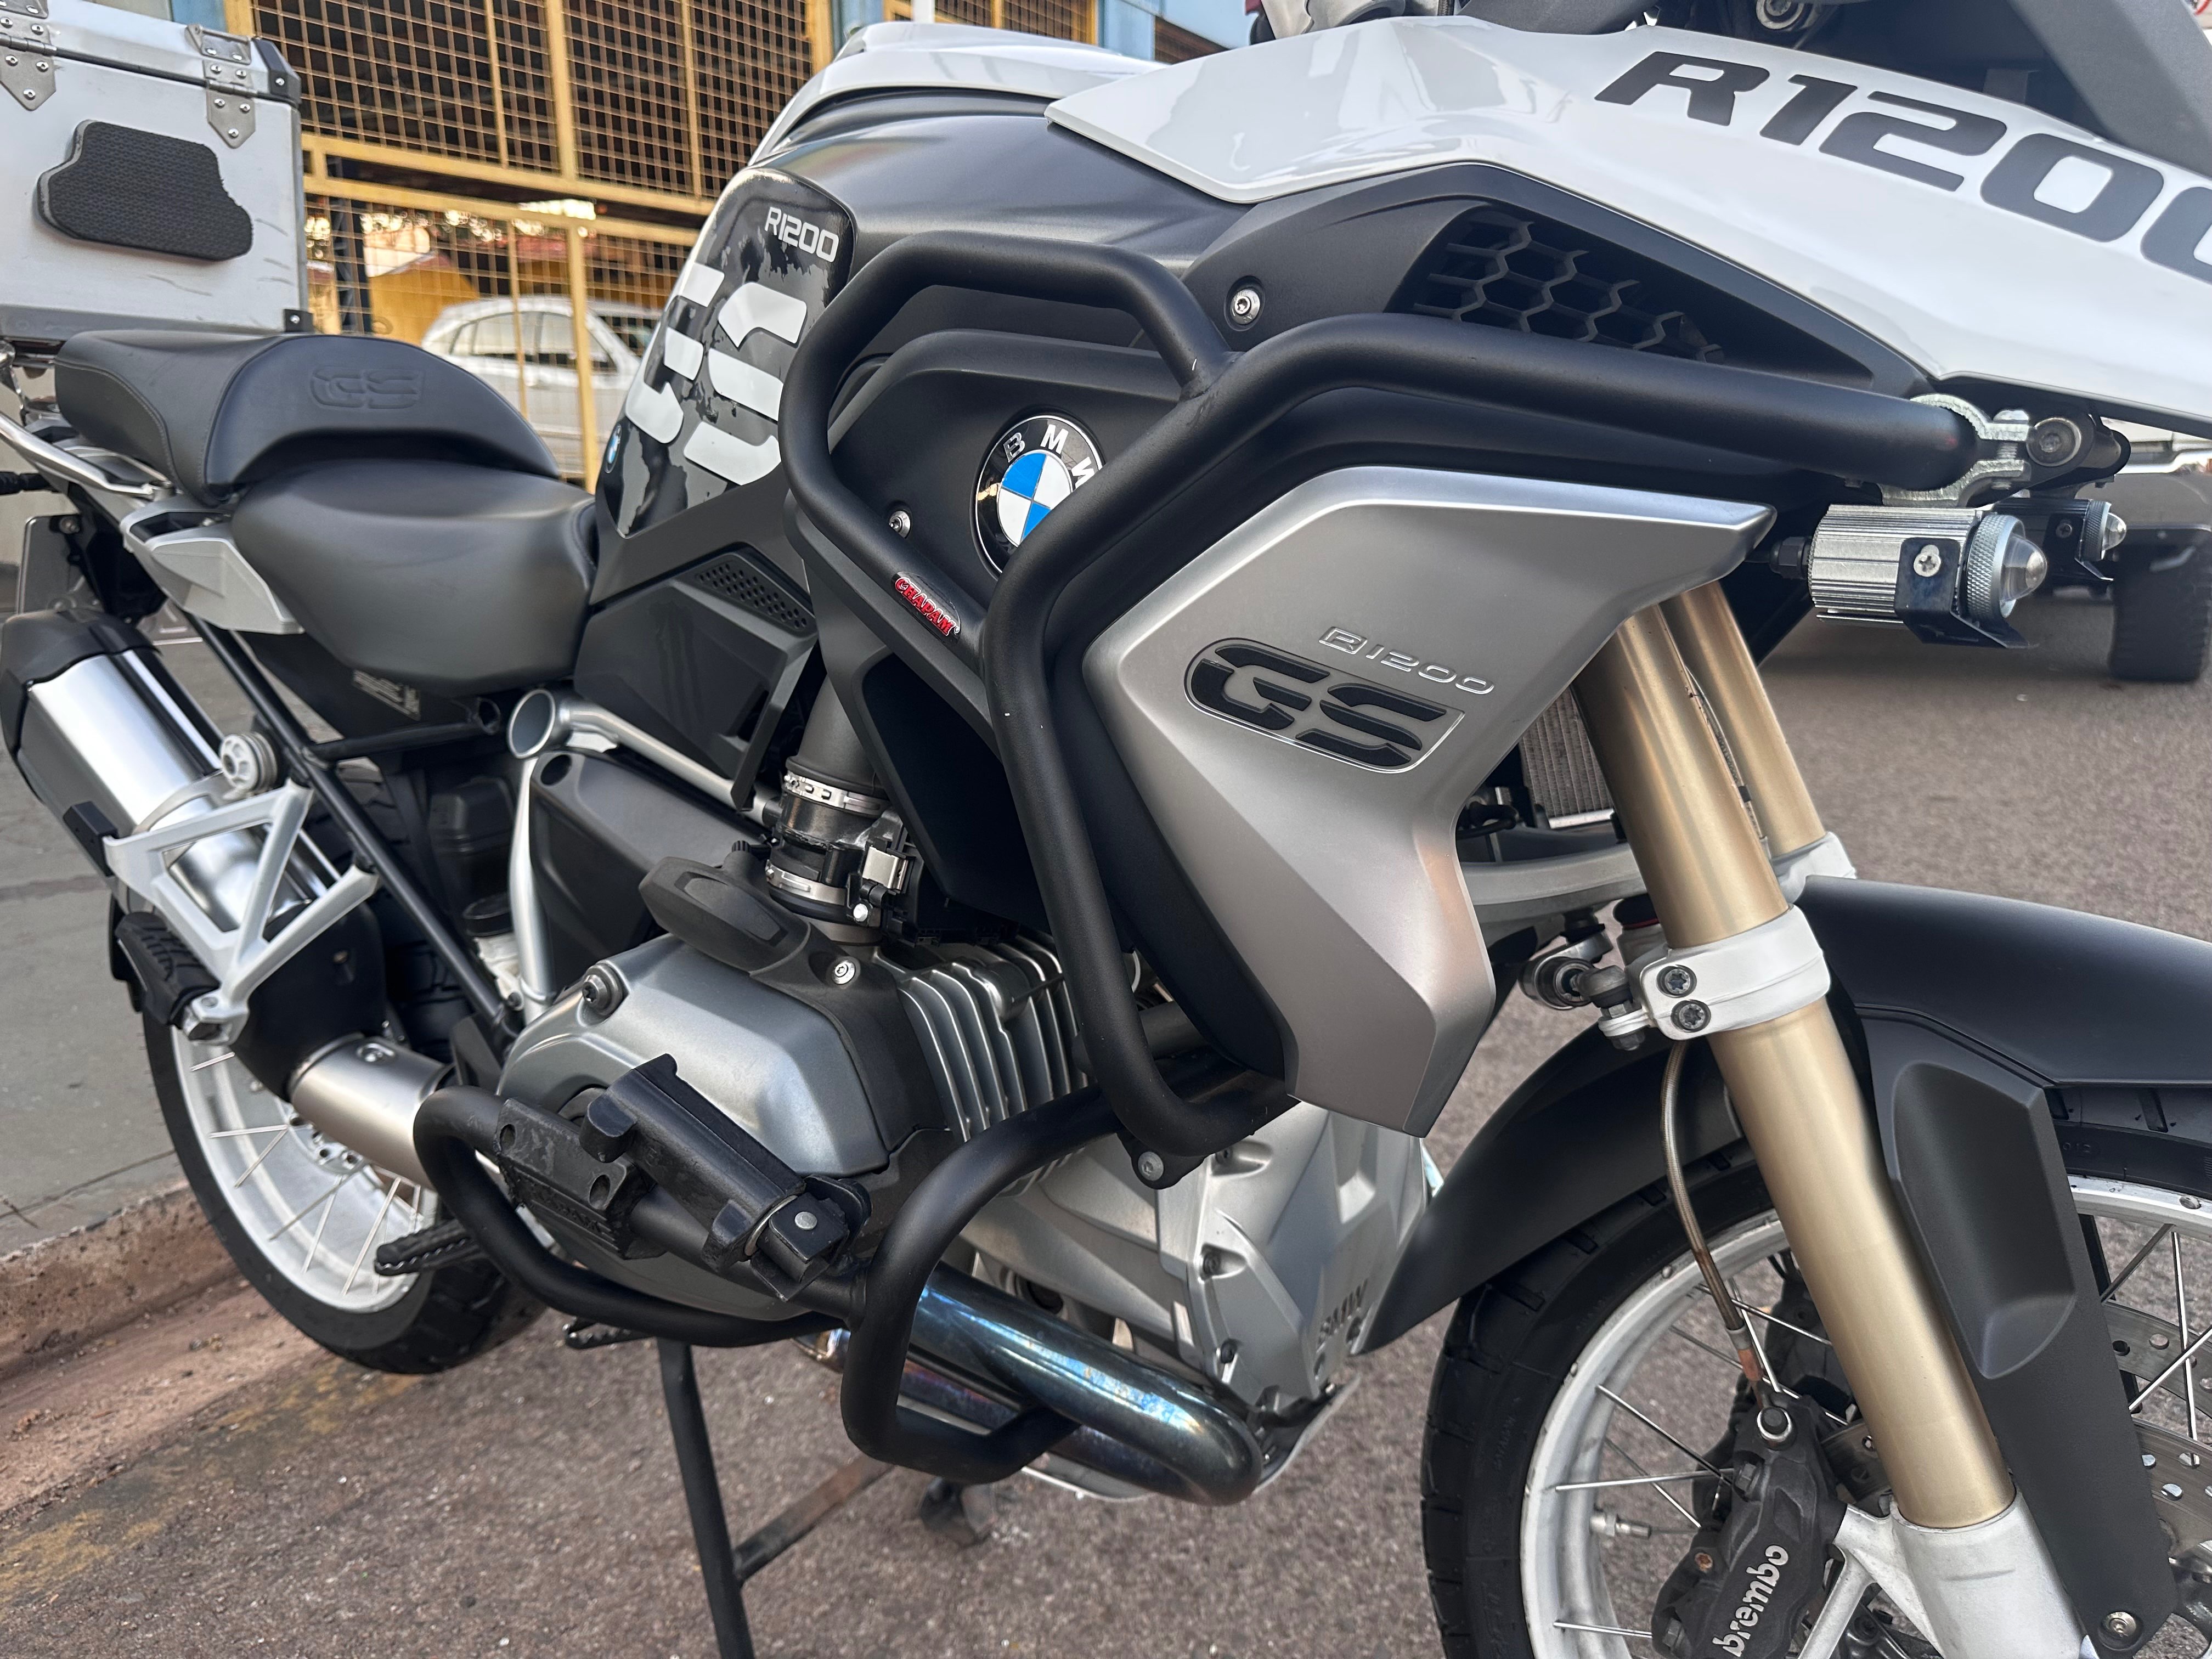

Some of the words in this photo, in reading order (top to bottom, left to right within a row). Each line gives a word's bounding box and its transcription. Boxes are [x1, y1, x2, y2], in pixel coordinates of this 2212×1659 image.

[764, 206, 839, 263] R1200
[1003, 424, 1096, 489] BMW
[895, 577, 957, 636] CHAPAM
[1190, 644, 1447, 767] GS
[1712, 1544, 1789, 1657] brembo
